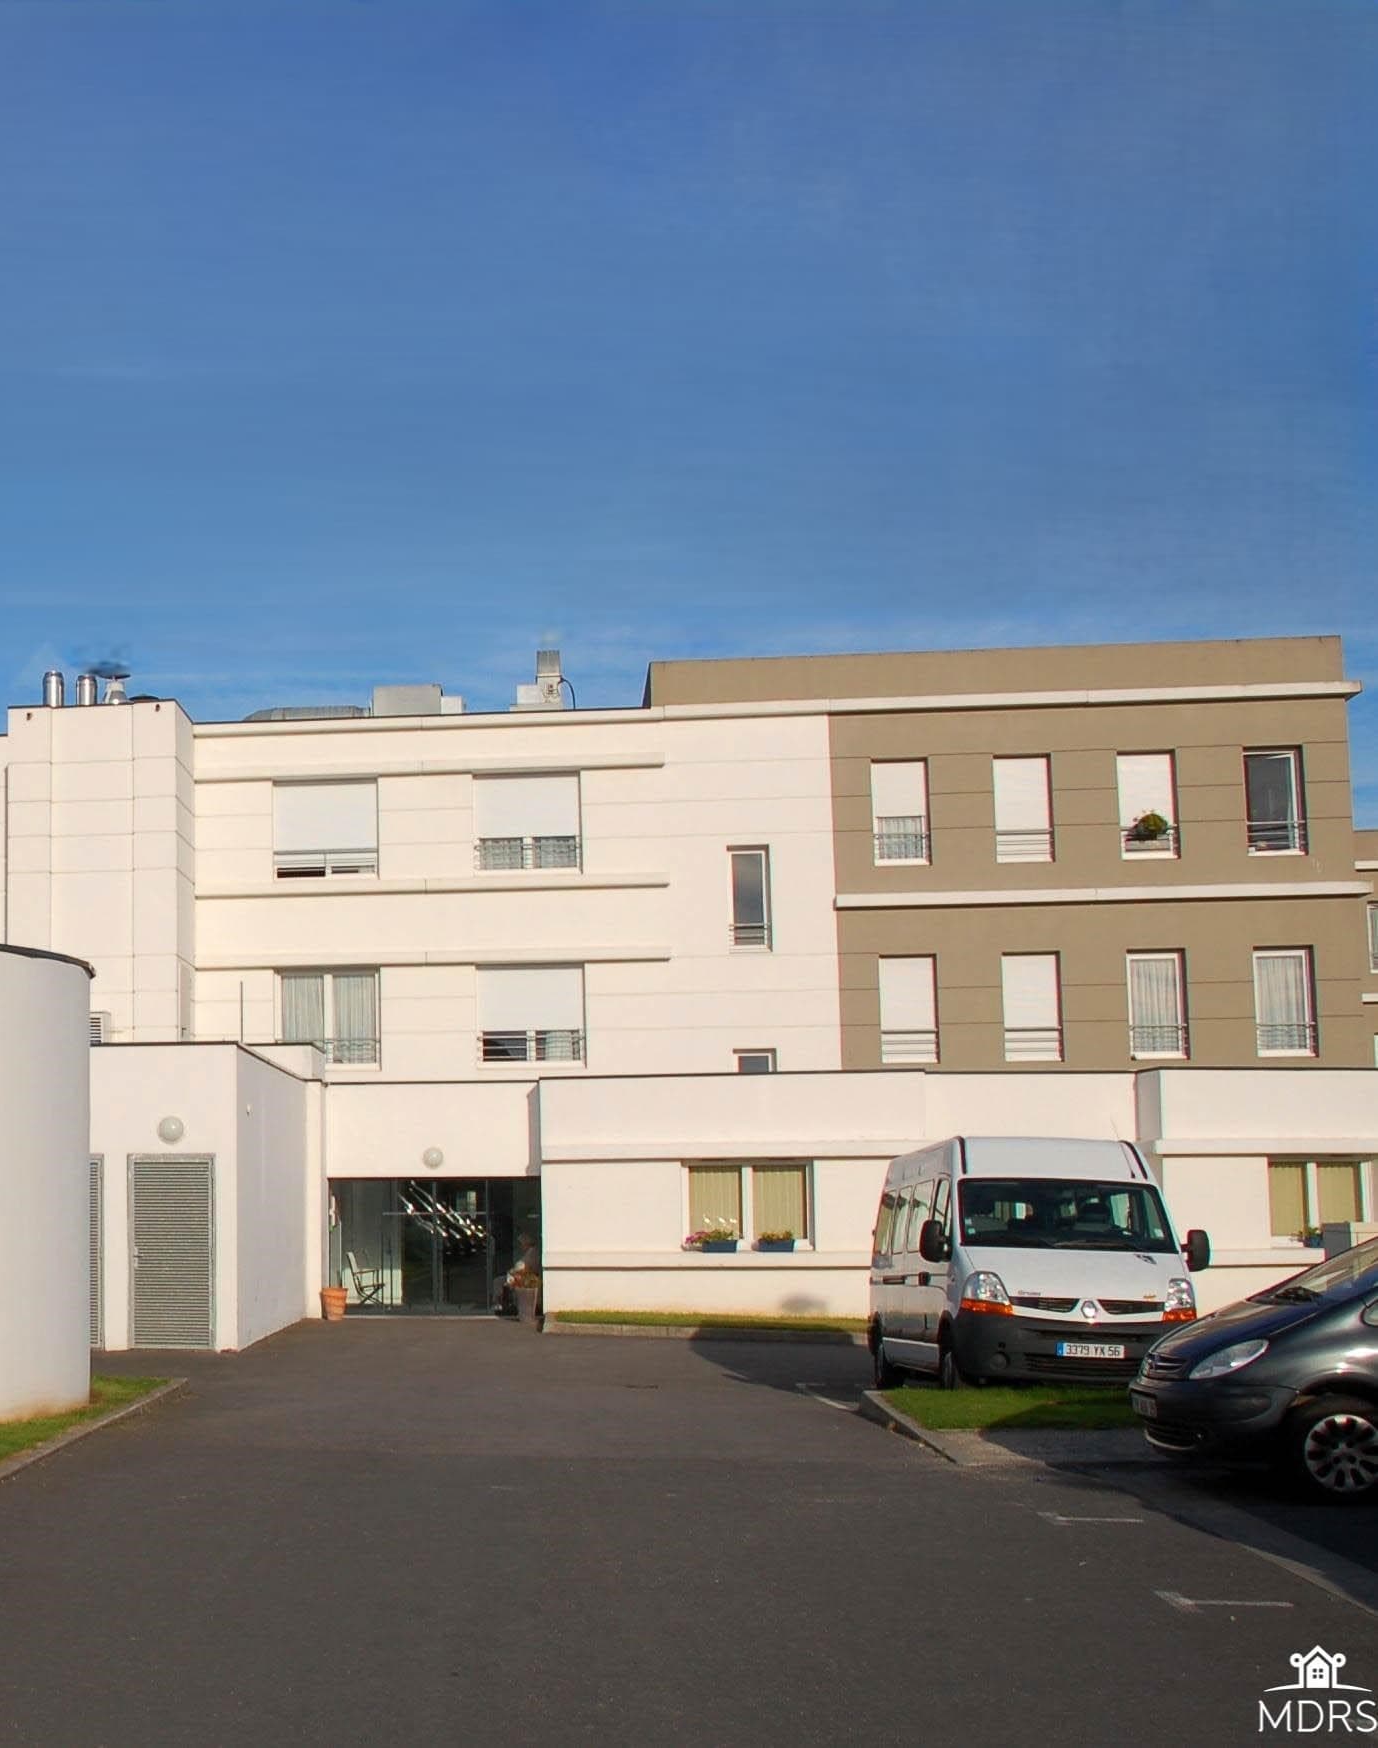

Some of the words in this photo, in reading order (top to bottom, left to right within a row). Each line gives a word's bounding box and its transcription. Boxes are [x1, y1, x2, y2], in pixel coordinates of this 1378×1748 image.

[1066, 1344, 1090, 1355] 3379
[1093, 1345, 1105, 1356] YX
[1108, 1346, 1120, 1357] 56
